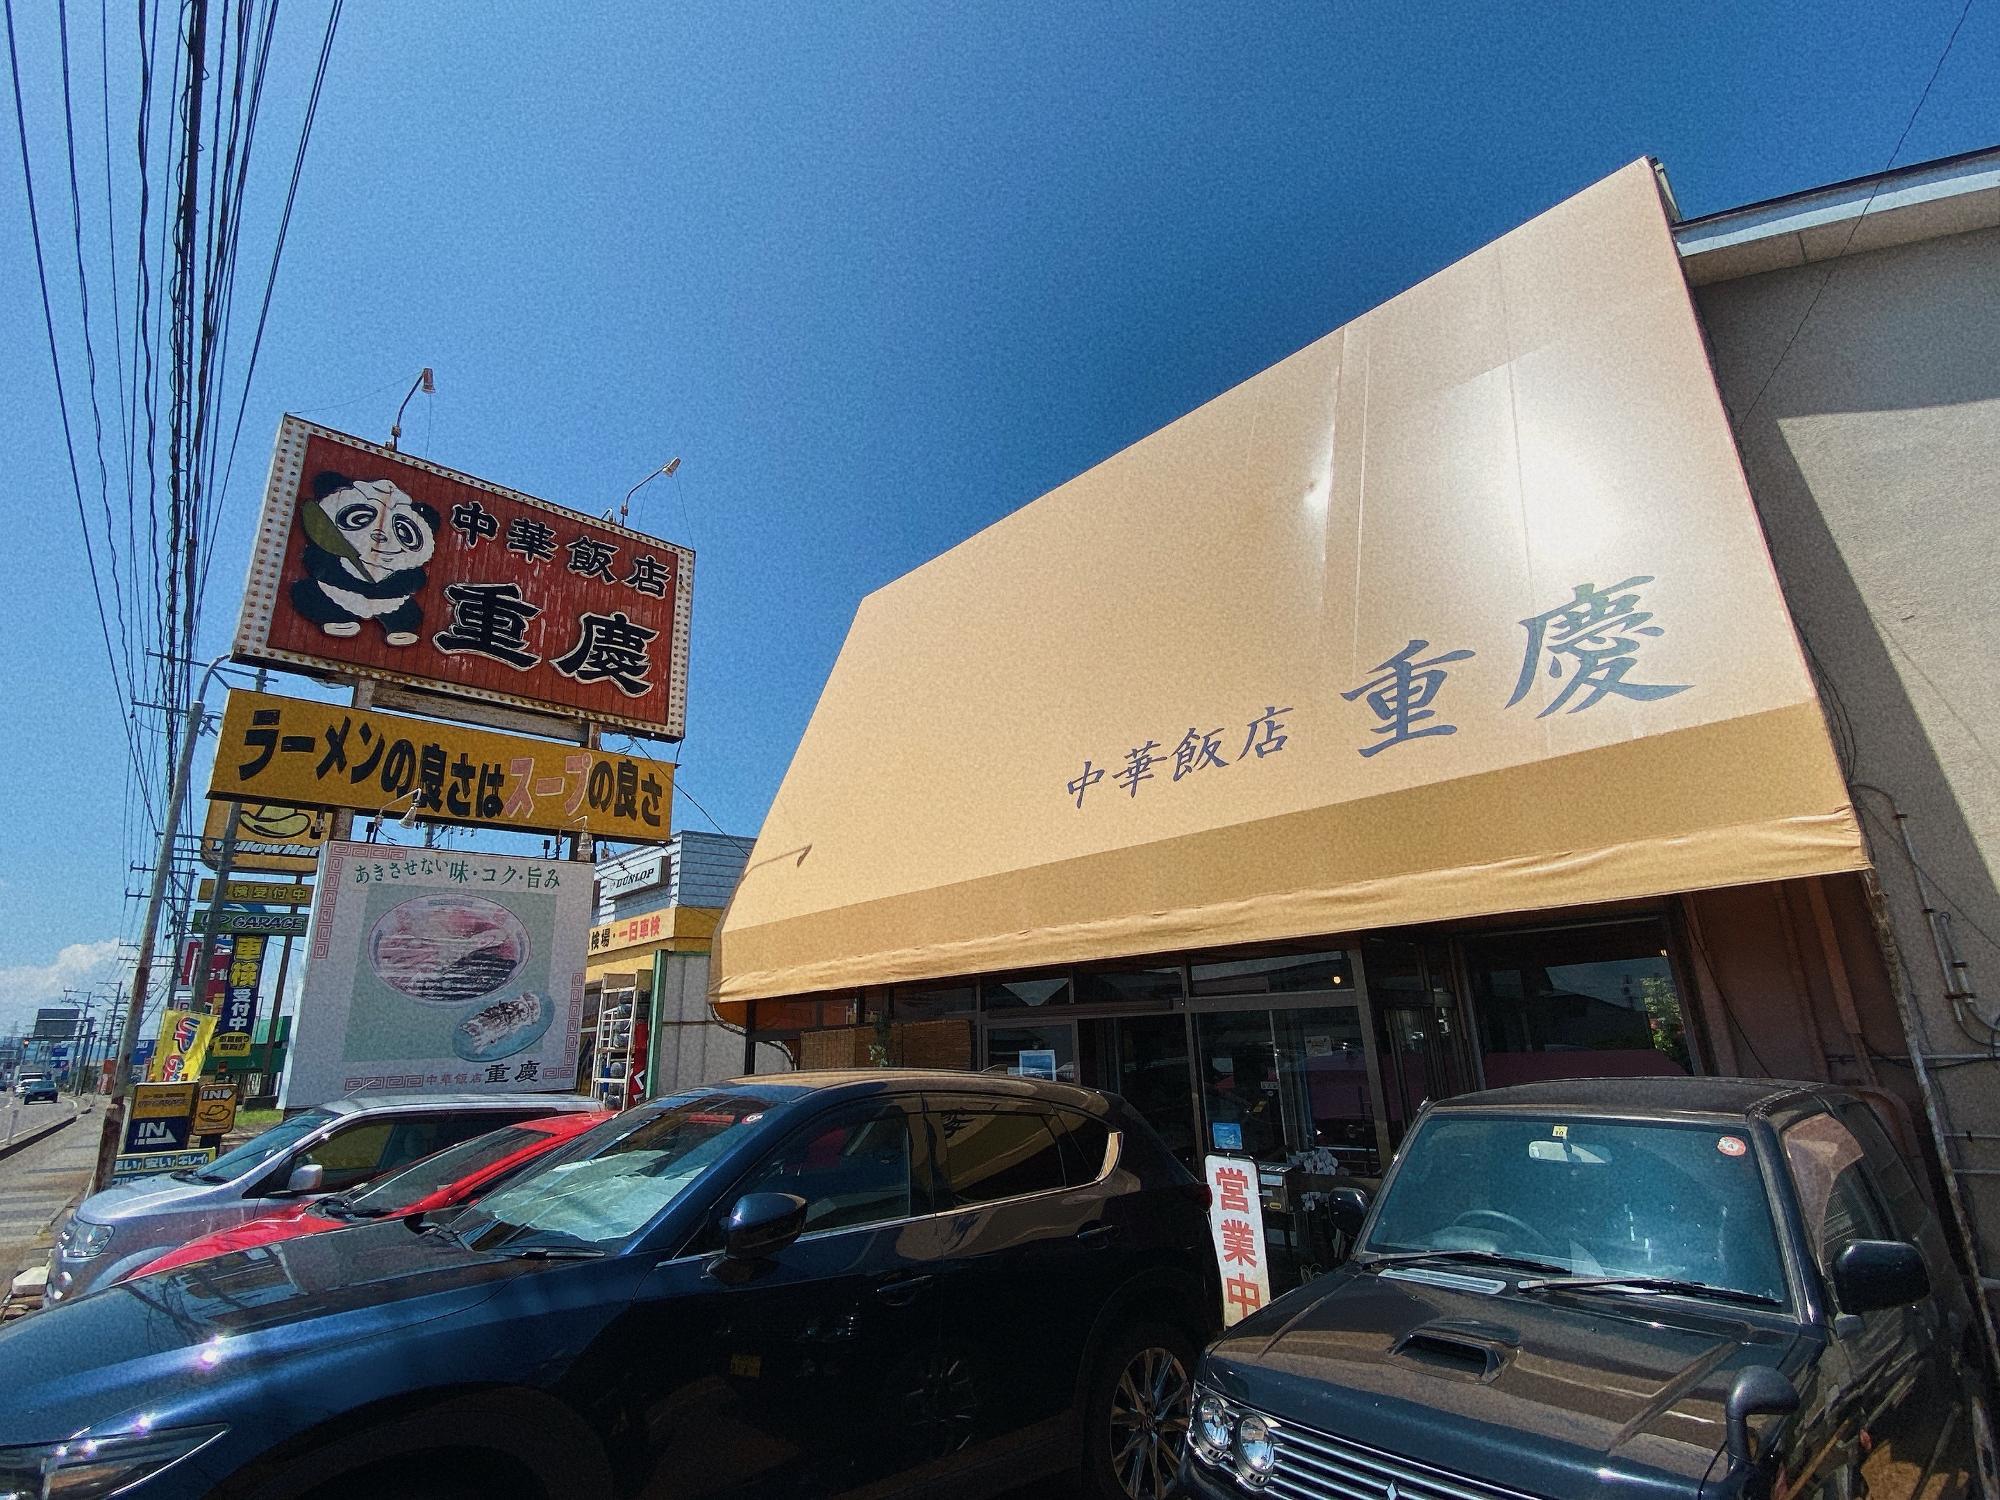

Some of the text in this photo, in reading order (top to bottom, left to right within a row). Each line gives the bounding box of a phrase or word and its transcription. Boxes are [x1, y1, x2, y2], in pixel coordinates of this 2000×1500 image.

[450, 500, 672, 598] 中華飯店
[431, 582, 661, 698] 重慶
[1066, 575, 1695, 810] 中華飯店 重慶
[238, 708, 663, 826] ラーメンの良さはスープの良さ
[228, 885, 307, 899] 検受付中
[616, 867, 655, 889] DUNLOP
[232, 915, 306, 930] GARAGE
[588, 915, 661, 951] 検場・一日車検
[425, 1060, 541, 1086] 中華飯店 重慶
[203, 1090, 222, 1100] IN
[138, 1121, 166, 1138] IN
[1215, 1166, 1262, 1318] 営業中
